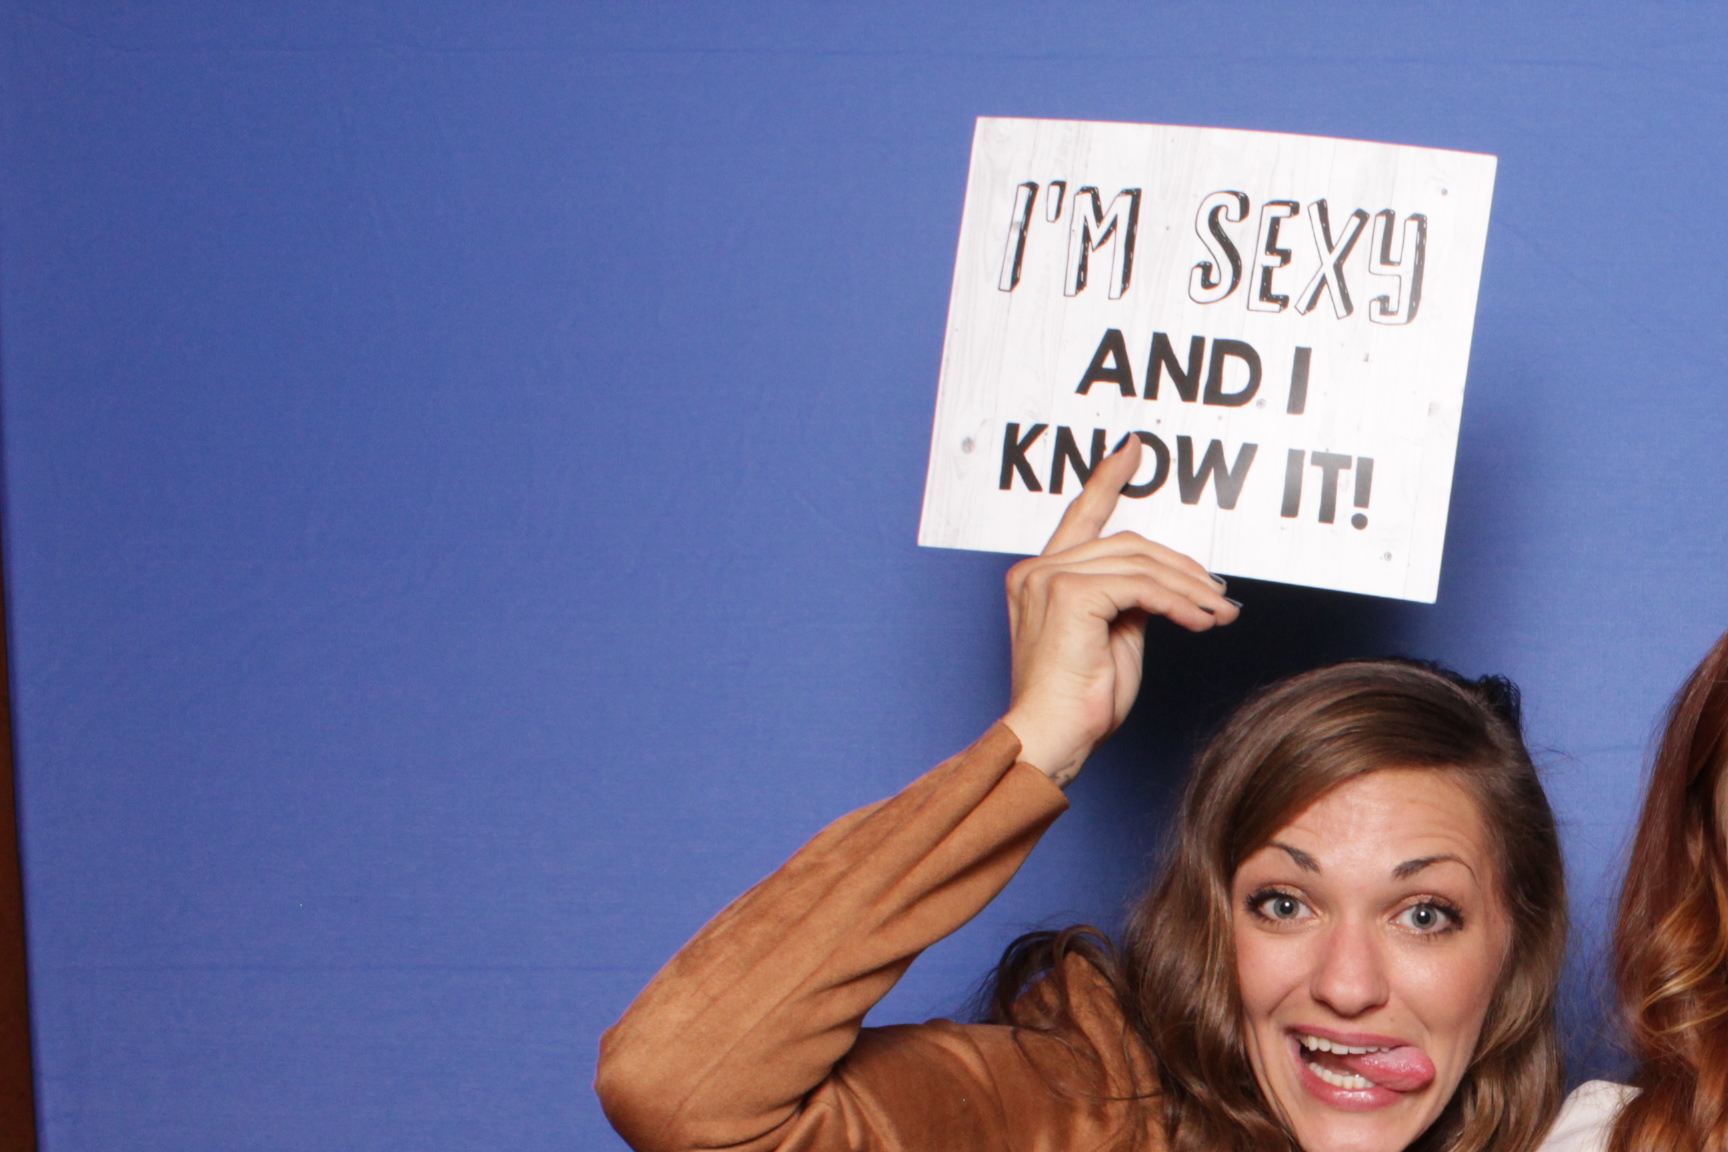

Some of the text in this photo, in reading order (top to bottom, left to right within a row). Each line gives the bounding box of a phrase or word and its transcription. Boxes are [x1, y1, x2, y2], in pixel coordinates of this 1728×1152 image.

[999, 180, 1428, 326] I'M SEXY
[1075, 328, 1312, 416] AND I
[999, 422, 1374, 530] KNOW IT!
